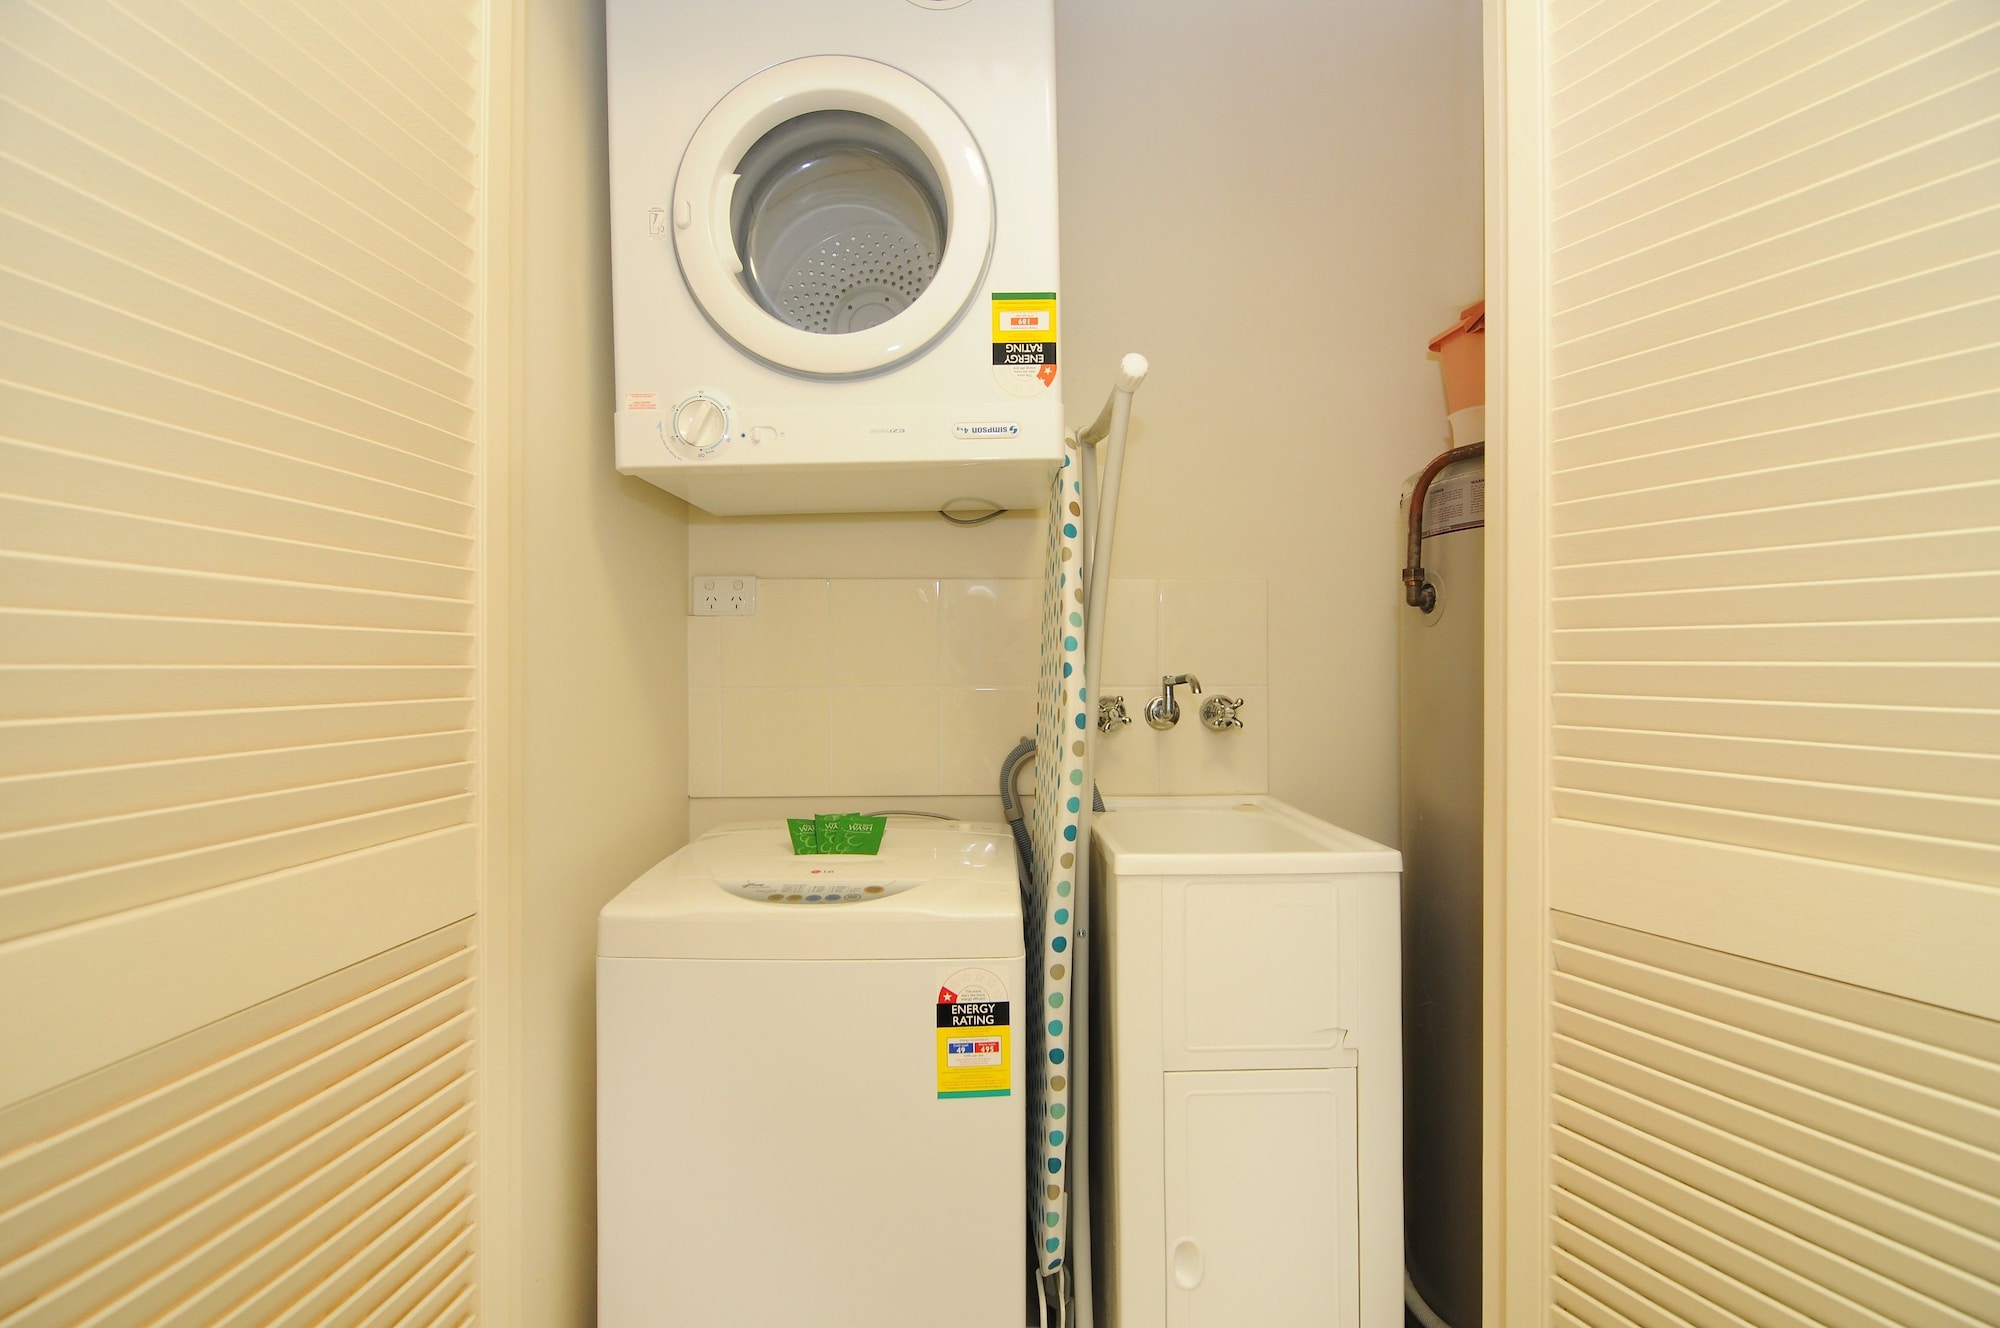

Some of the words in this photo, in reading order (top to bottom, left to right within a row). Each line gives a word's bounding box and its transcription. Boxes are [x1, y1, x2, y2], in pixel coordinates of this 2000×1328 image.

[1005, 343, 1043, 353] RATING
[1004, 354, 1044, 363] ENERGY
[971, 426, 1008, 434] SIMPSON
[848, 823, 873, 831] WASH
[951, 1004, 995, 1014] ENERGY
[952, 1015, 995, 1026] RATING
